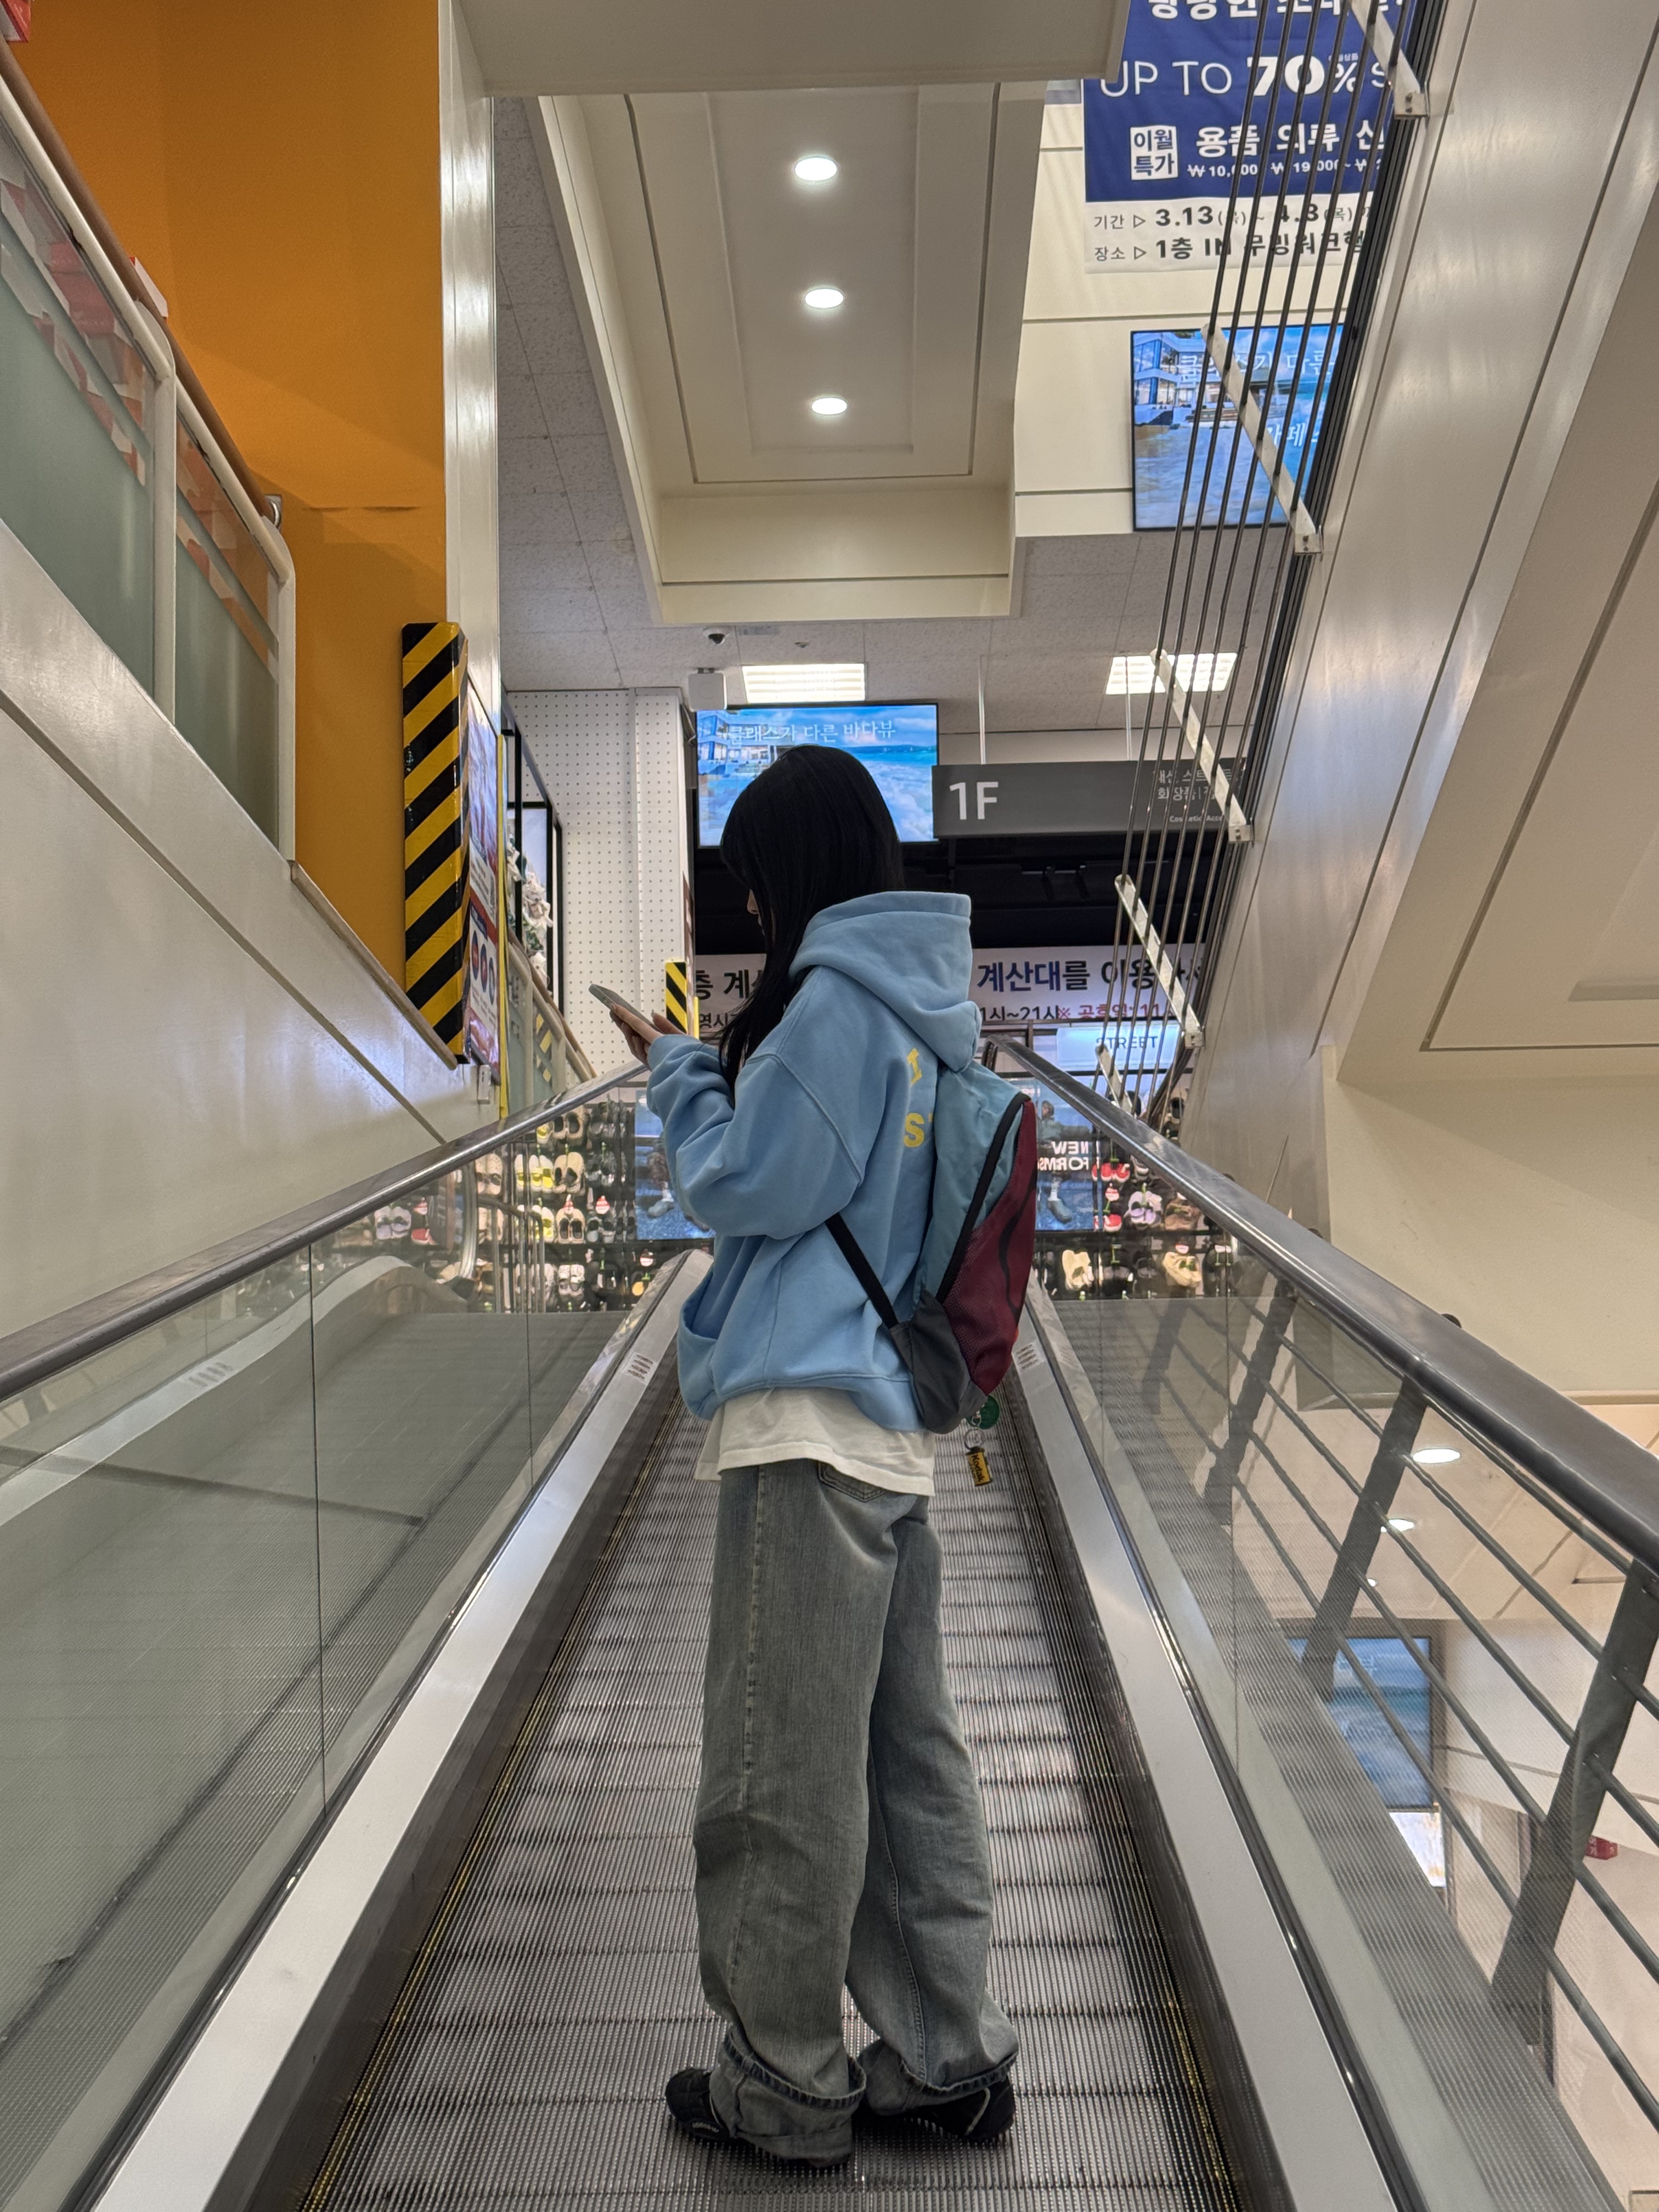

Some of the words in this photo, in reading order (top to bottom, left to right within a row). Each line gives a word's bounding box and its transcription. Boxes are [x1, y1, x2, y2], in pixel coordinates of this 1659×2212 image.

[1100, 60, 1158, 97] UP
[1171, 61, 1232, 96] TO
[1134, 128, 1173, 151] 이월
[1134, 153, 1175, 177] 특가
[1094, 214, 1125, 230] 기간
[1094, 246, 1126, 262] 장소
[1155, 236, 1193, 260] 1층
[1204, 237, 1232, 257] IN
[804, 723, 839, 743] 다른
[843, 719, 896, 739] 바다뷰
[949, 781, 999, 820] 1F
[977, 960, 1091, 992] 계산대를
